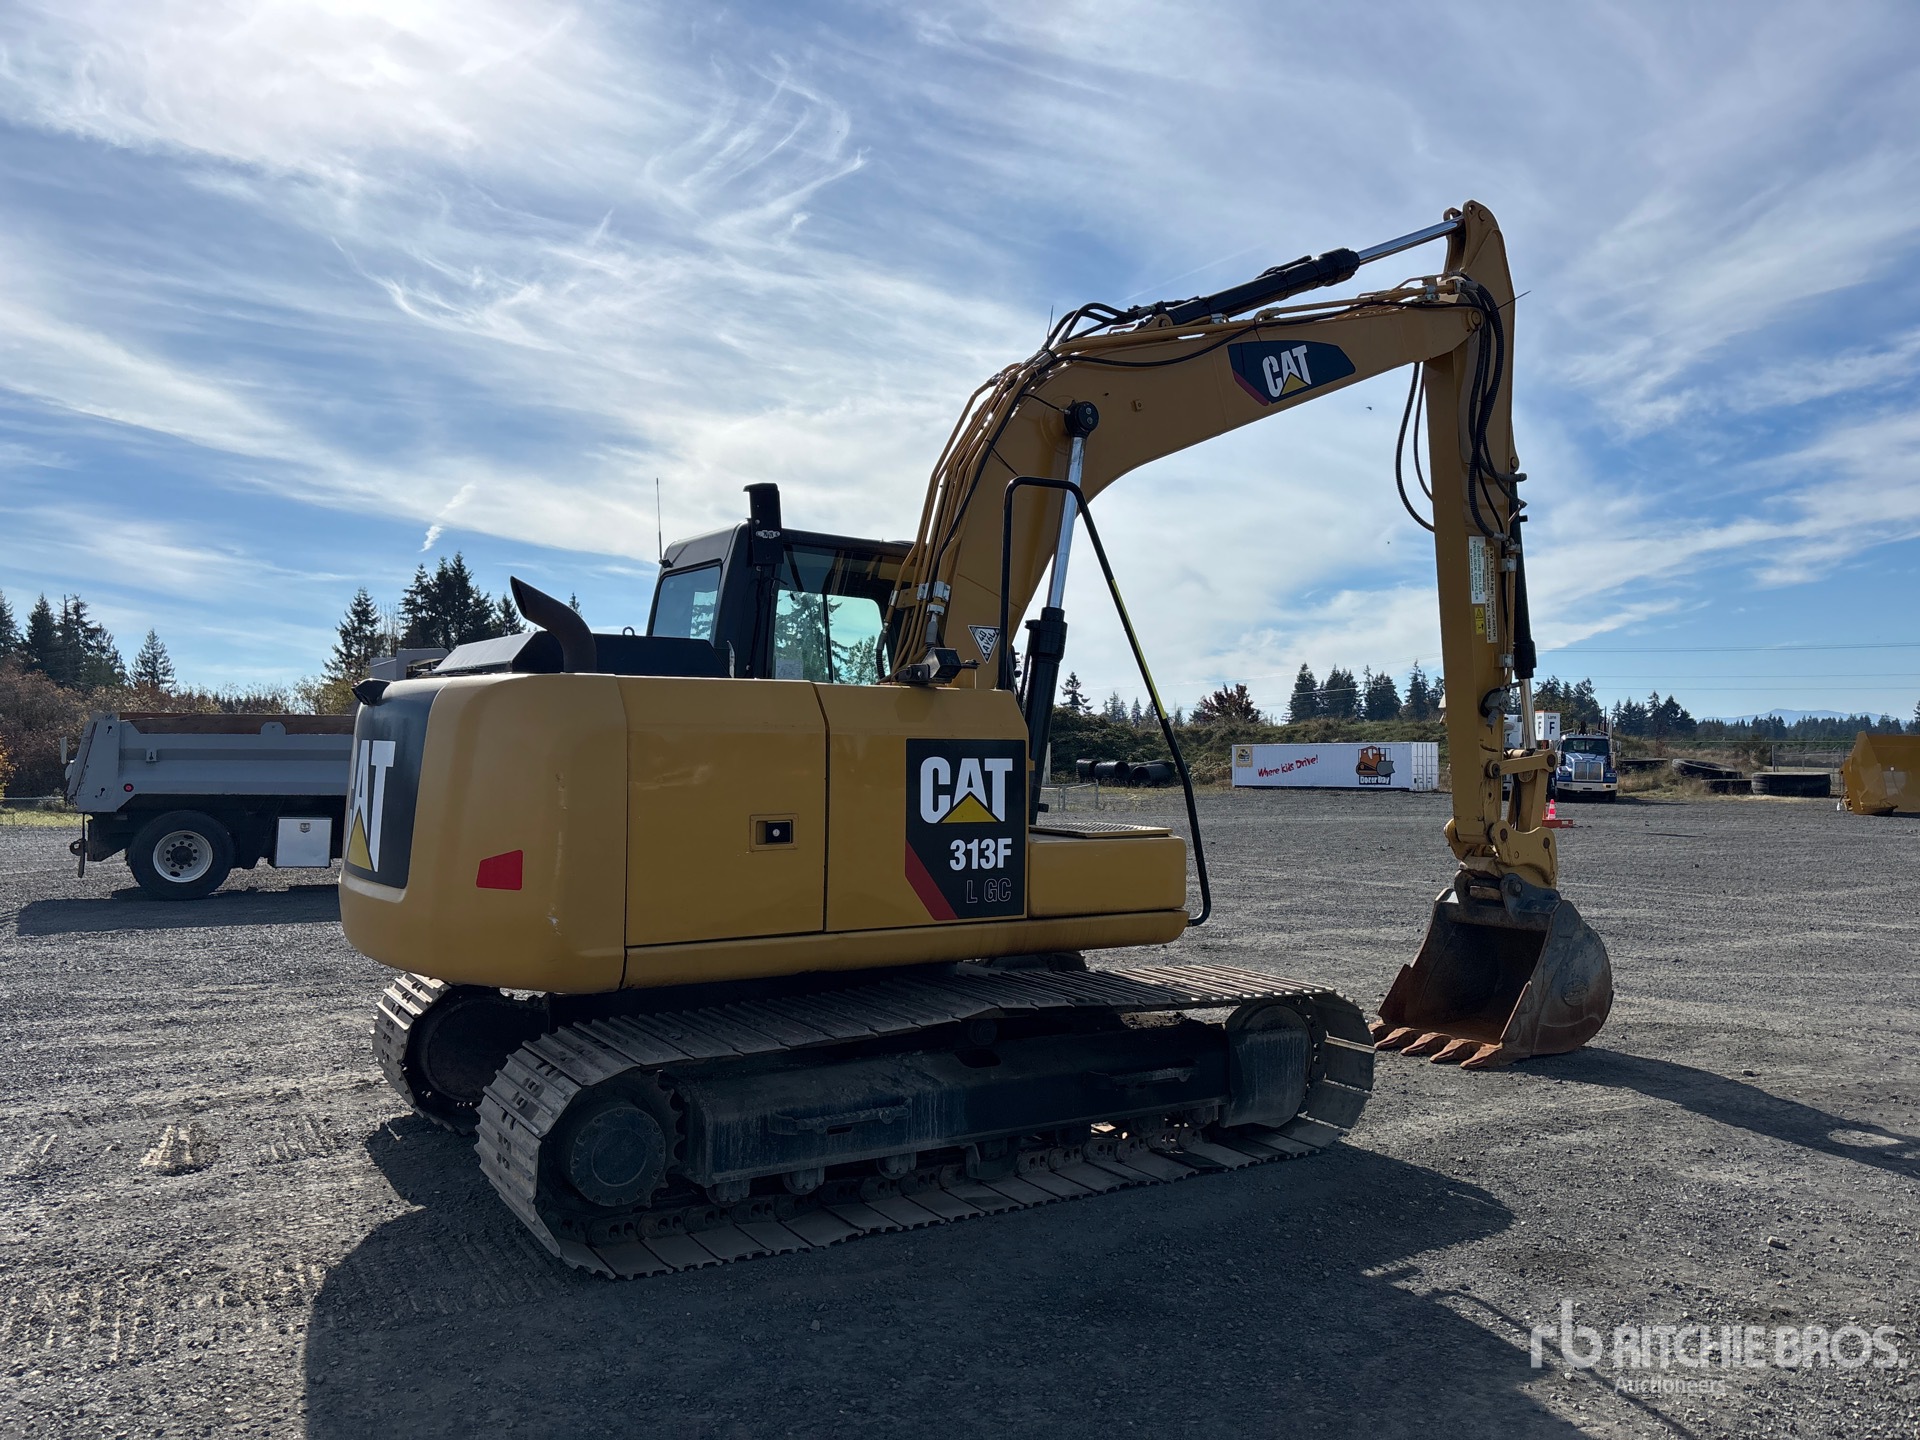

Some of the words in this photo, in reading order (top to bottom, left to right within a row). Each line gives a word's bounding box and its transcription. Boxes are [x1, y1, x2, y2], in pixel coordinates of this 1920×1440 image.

[1262, 344, 1312, 397] CAT
[1549, 722, 1555, 734] F
[1258, 766, 1280, 777] Where
[1295, 754, 1319, 769] Drive!
[920, 756, 1013, 824] CAT
[949, 838, 1012, 871] 313F
[966, 880, 978, 903] L
[984, 878, 1012, 903] GC
